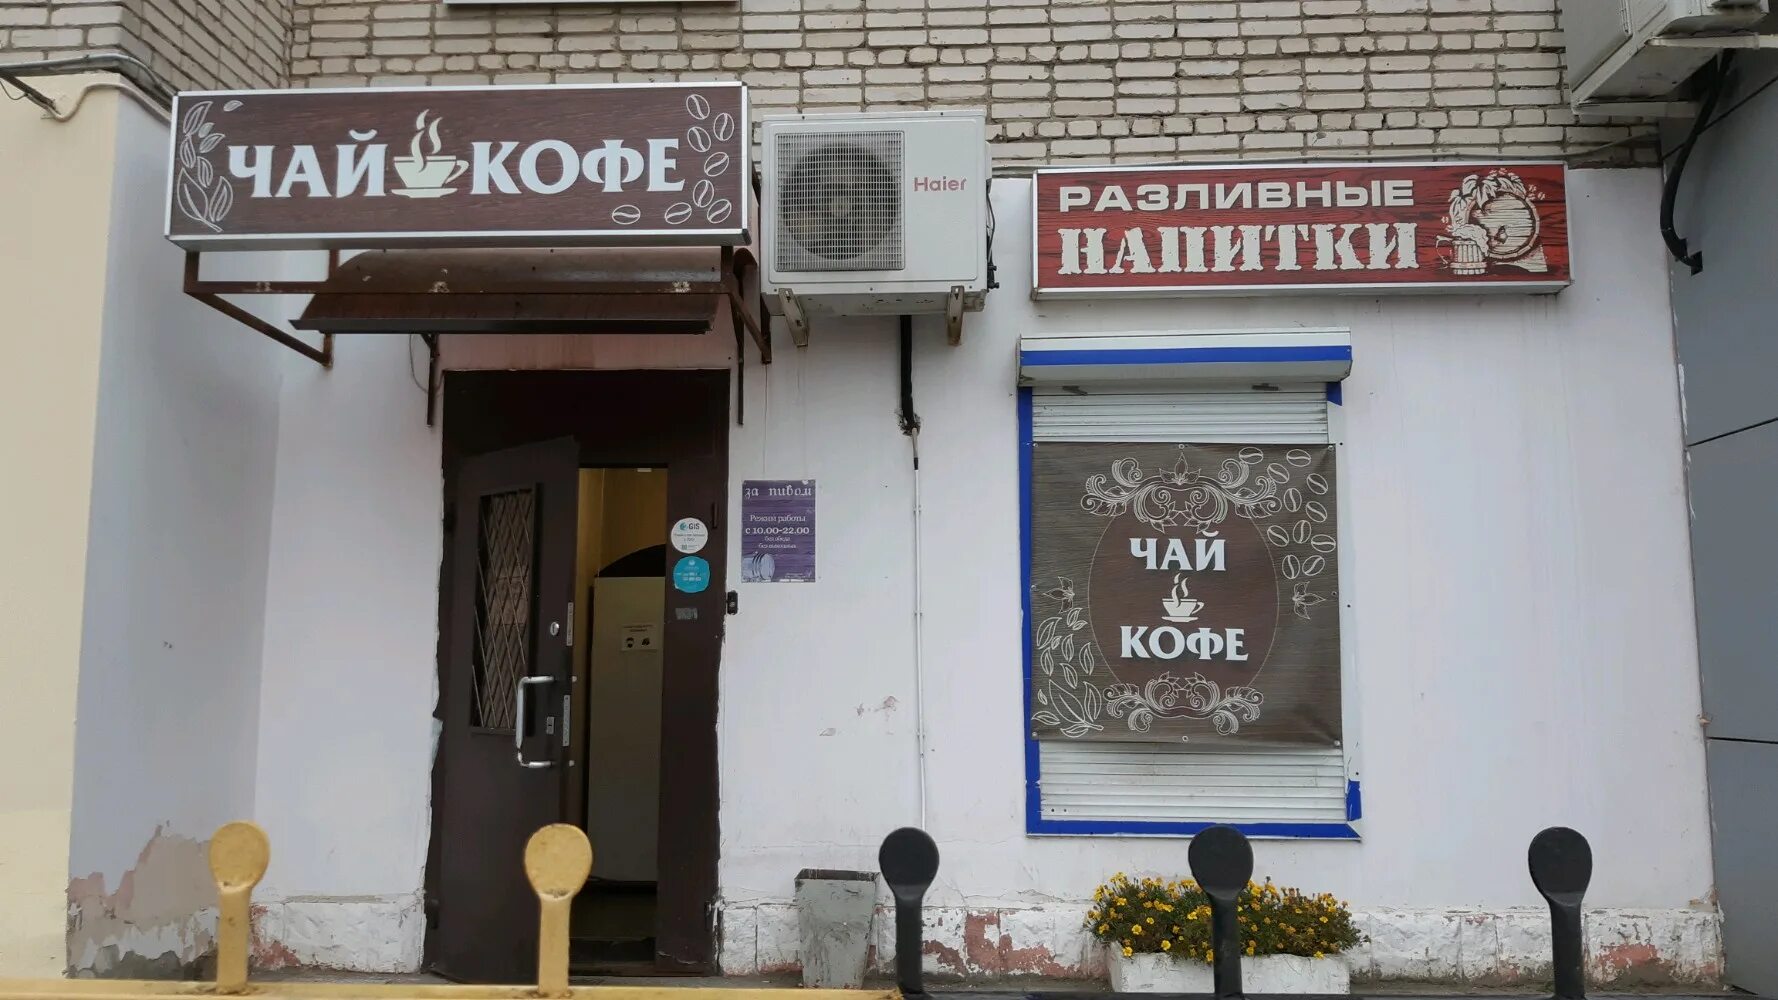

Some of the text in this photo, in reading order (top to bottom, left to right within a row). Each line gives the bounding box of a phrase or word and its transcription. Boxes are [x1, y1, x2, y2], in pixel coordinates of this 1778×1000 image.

[228, 129, 686, 198] ЧАЙ КОФЕ
[913, 176, 967, 192] Haier
[1058, 179, 1414, 213] РАЗЛИВНЫЕ
[1057, 222, 1420, 275] НАПИТКИ
[744, 484, 812, 499] за пивом
[750, 514, 806, 523] Режим работы
[1129, 530, 1226, 572] ЧАЙ
[1120, 625, 1249, 661] КОФЕ
